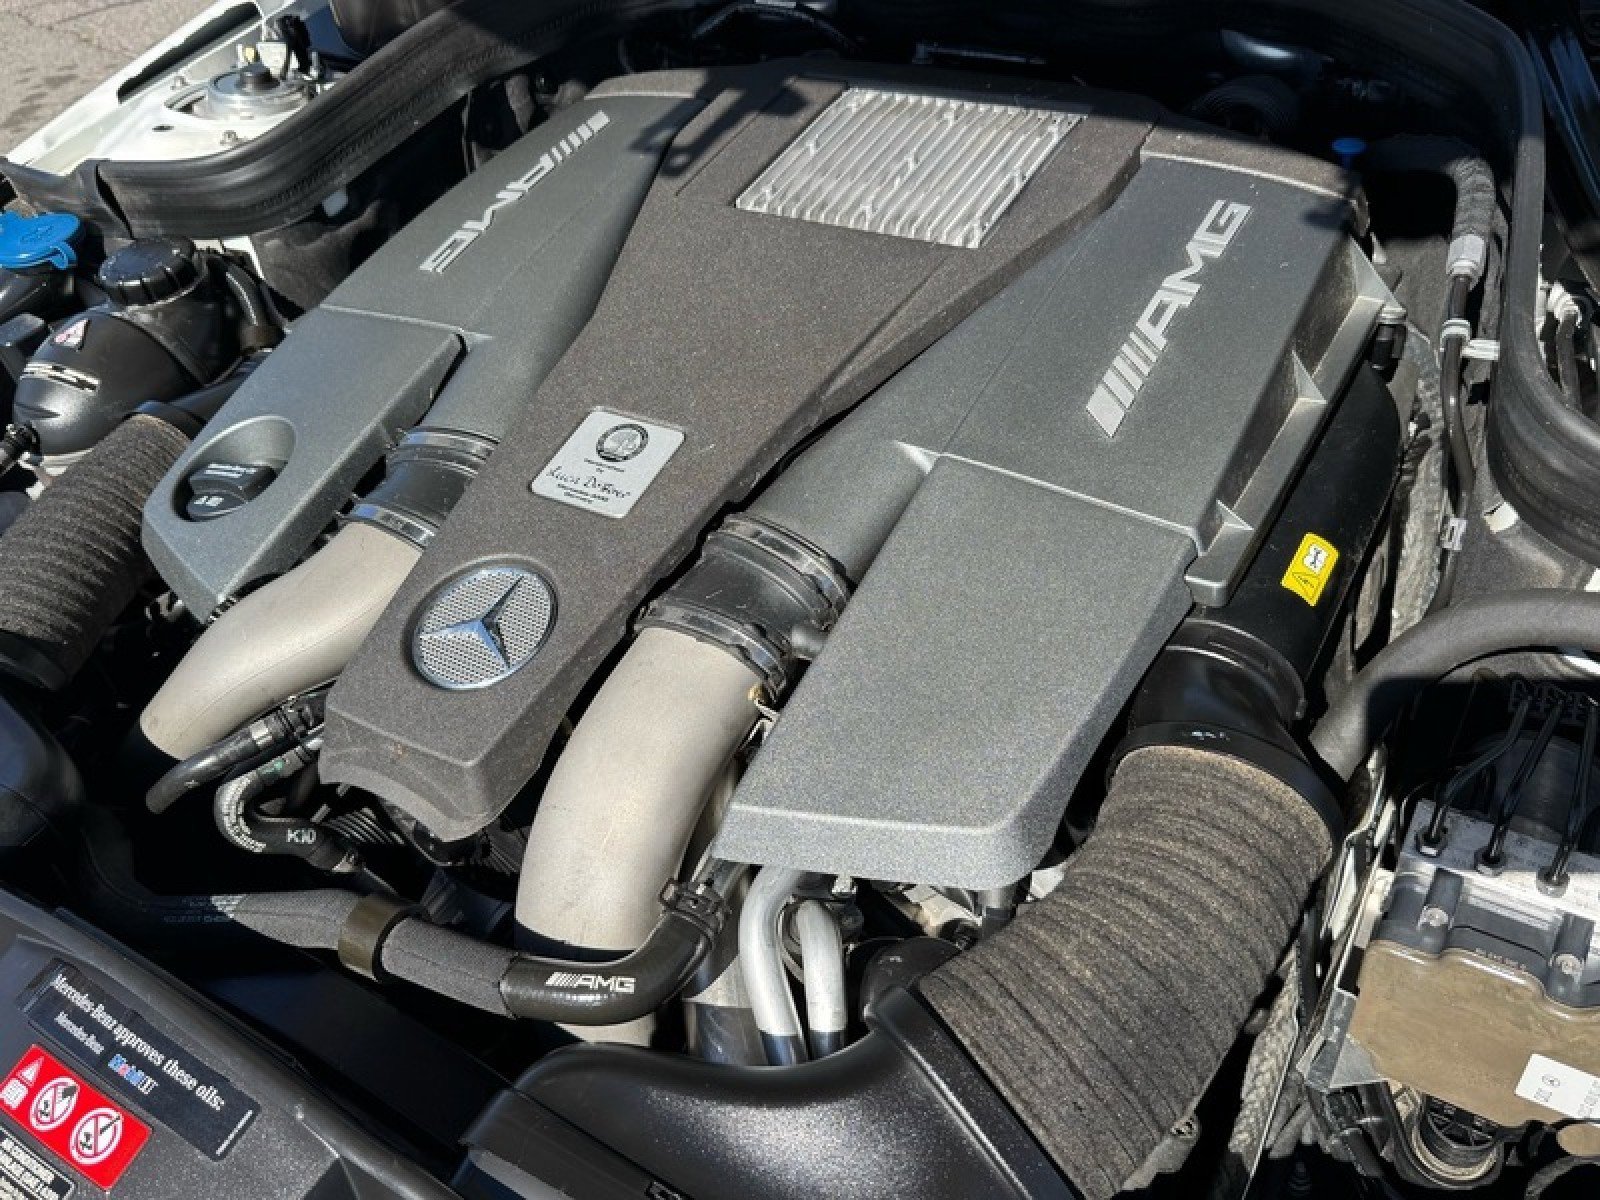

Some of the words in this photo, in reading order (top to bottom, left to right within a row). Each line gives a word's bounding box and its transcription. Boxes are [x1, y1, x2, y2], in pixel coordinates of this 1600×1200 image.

[419, 153, 556, 275] AMG
[1135, 199, 1252, 351] AMG
[573, 973, 637, 995] AMG
[113, 1023, 165, 1067] approves
[162, 1058, 198, 1091] these
[195, 1085, 226, 1111] oils:
